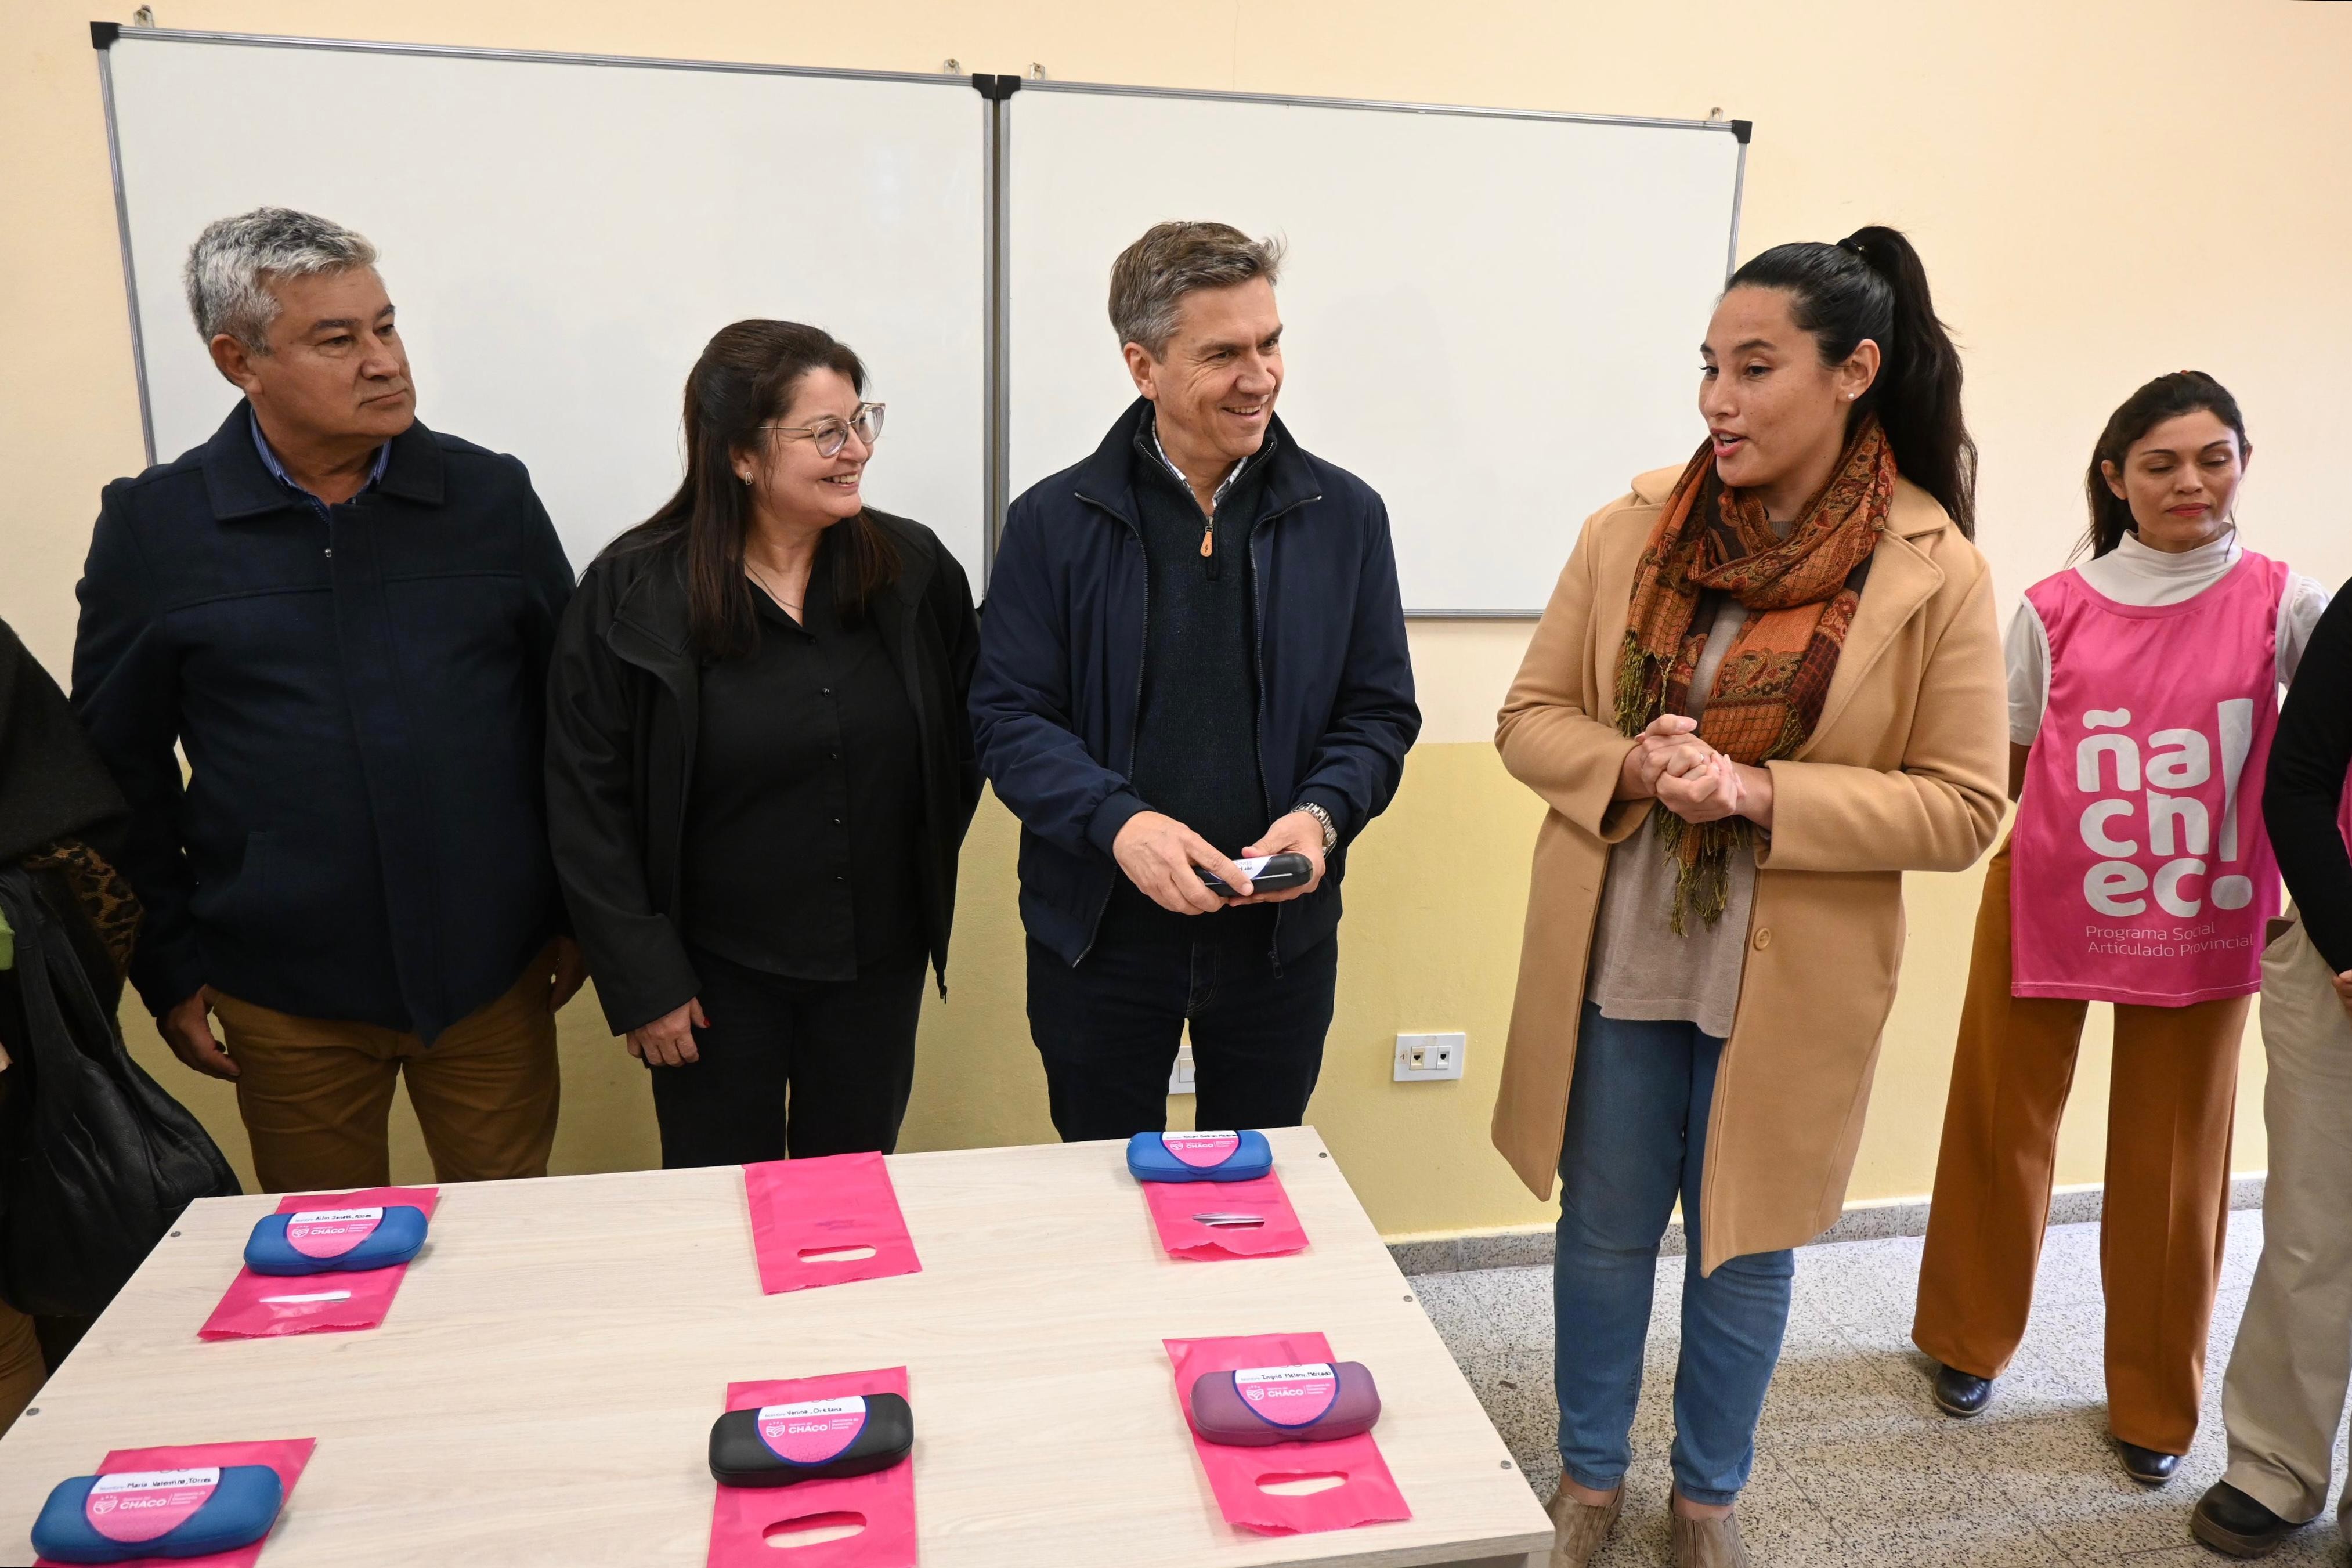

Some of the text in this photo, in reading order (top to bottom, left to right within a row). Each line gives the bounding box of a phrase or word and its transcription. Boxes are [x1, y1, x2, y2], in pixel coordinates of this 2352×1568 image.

[2086, 922, 2215, 941] Programa Social
[2088, 934, 2254, 956] Articulado Provincial
[311, 1227, 345, 1235] CHACO
[1267, 1389, 1304, 1397] CHACO
[789, 1424, 828, 1434] CHACO
[120, 1500, 168, 1509] CHACO
